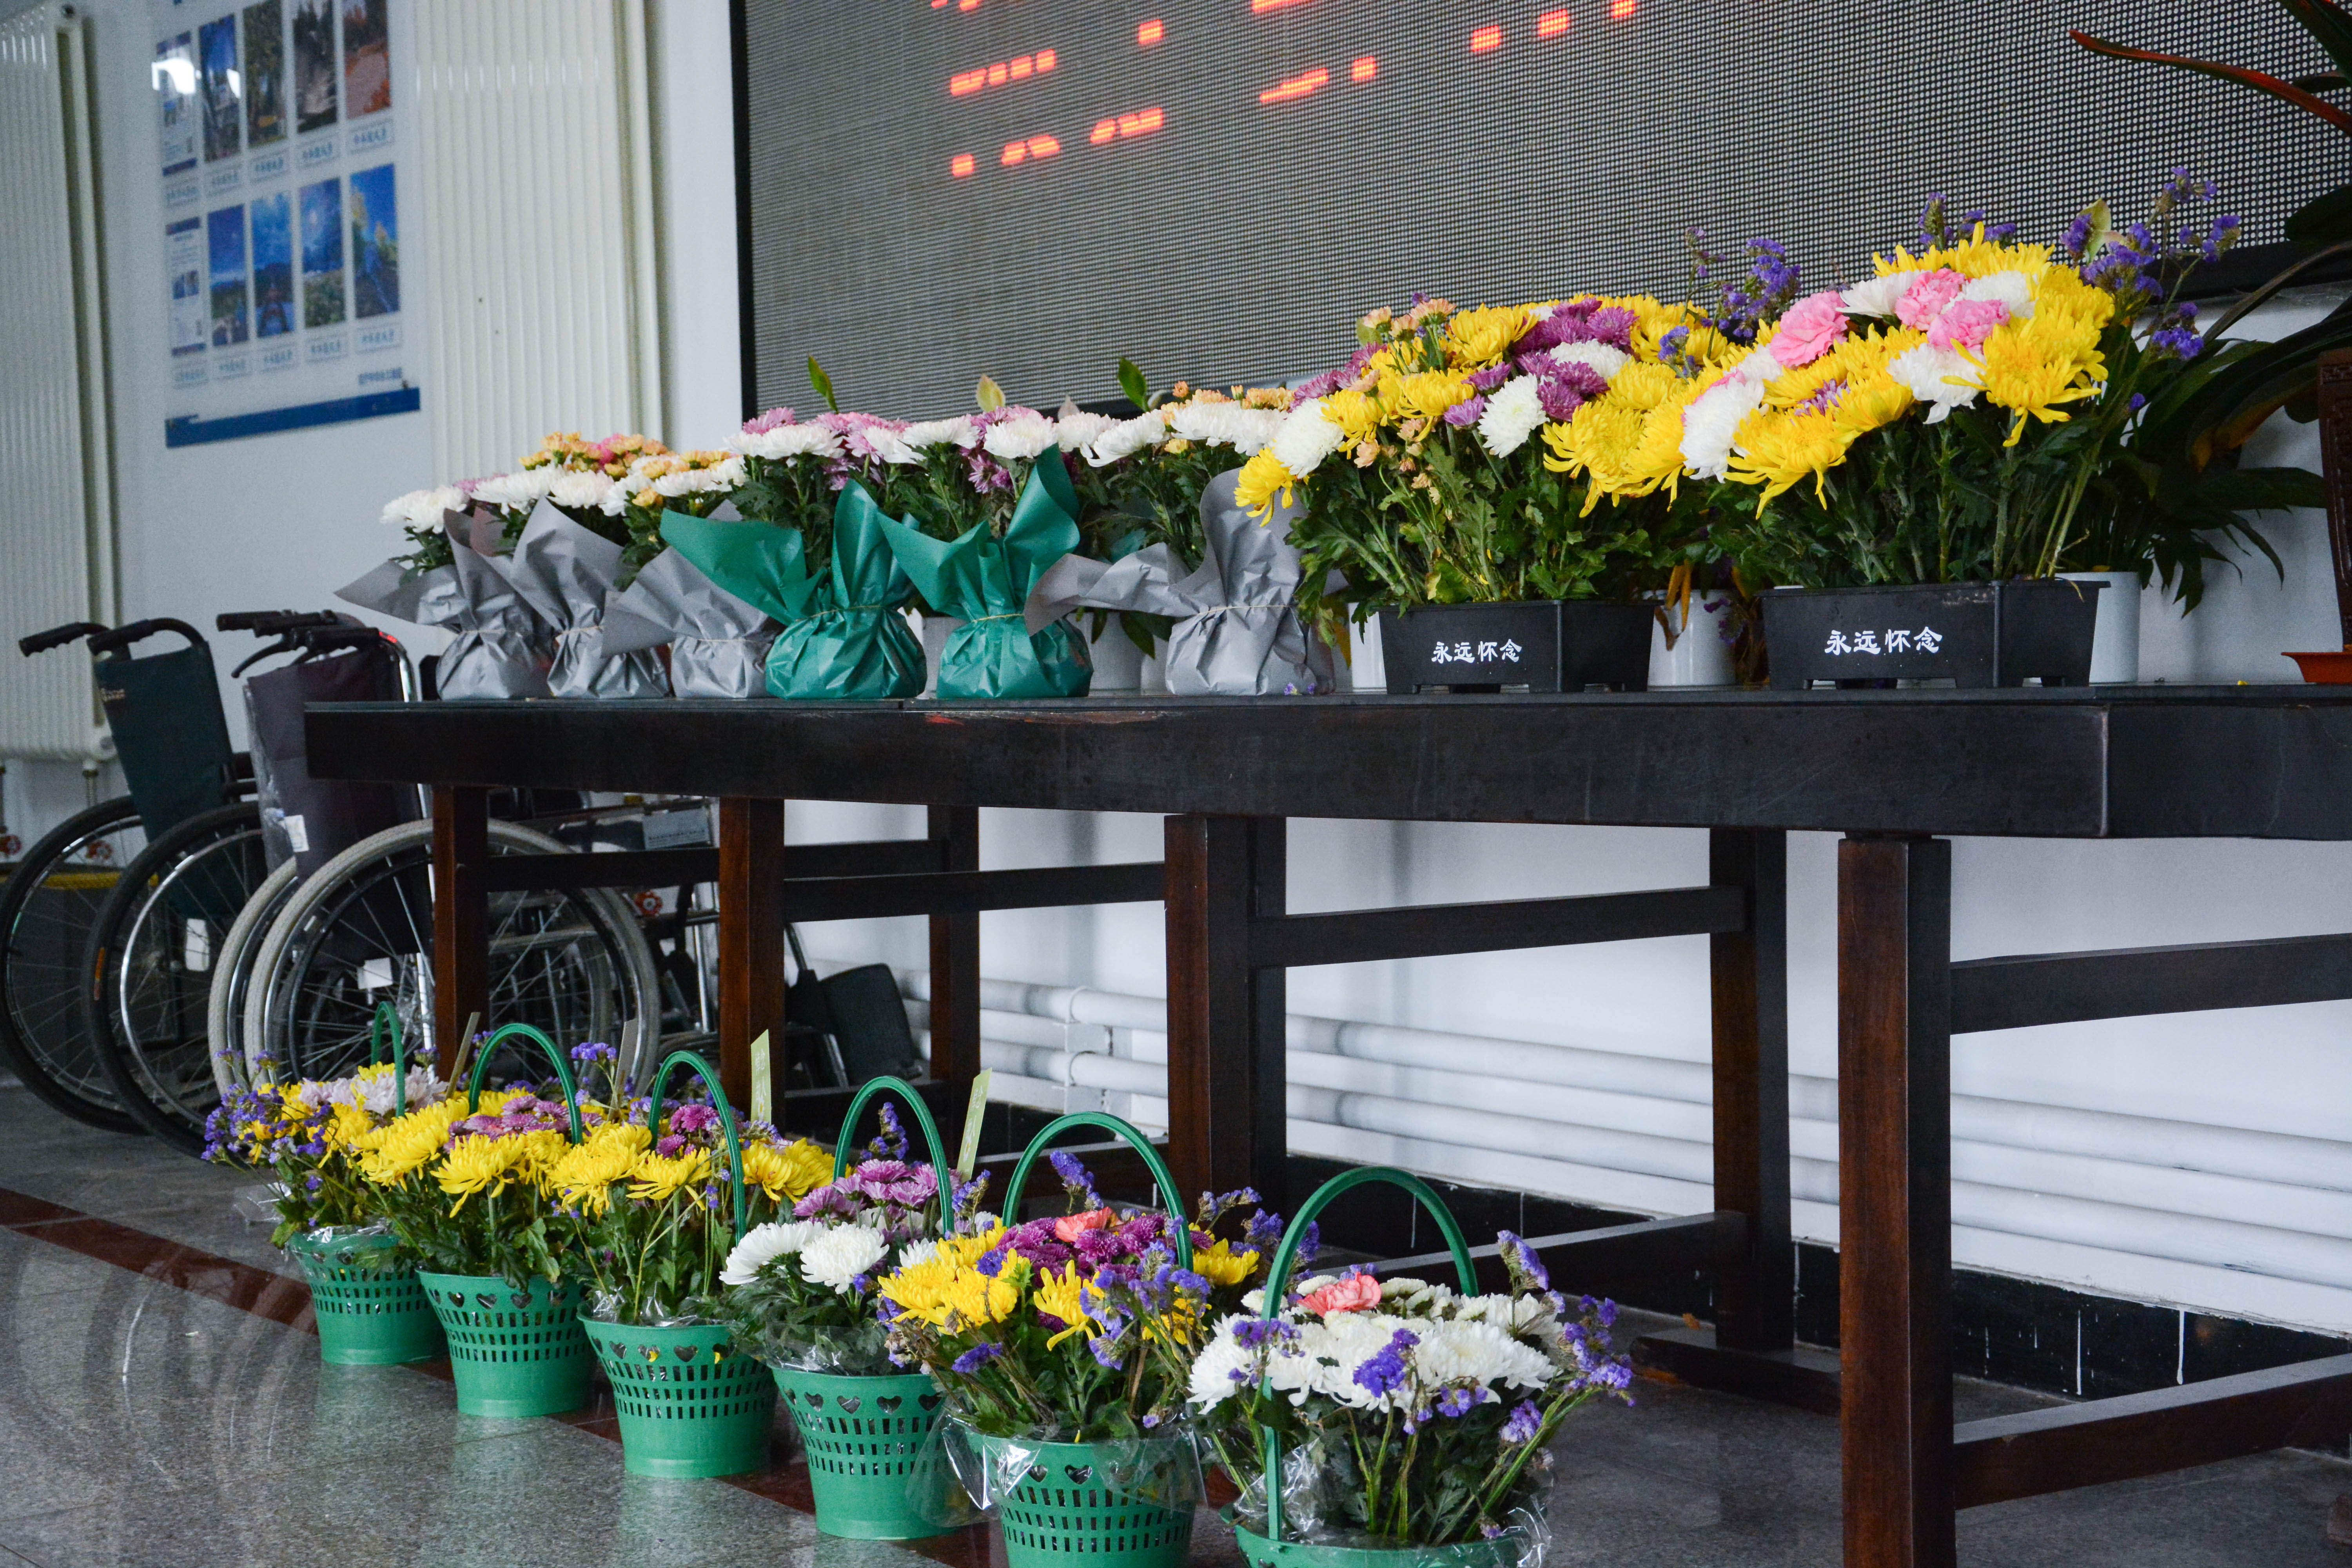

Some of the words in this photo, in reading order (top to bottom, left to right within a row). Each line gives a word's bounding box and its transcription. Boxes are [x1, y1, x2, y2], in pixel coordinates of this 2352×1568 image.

[1431, 639, 1523, 664] 永远怀念
[1824, 626, 1943, 656] 永远怀念
